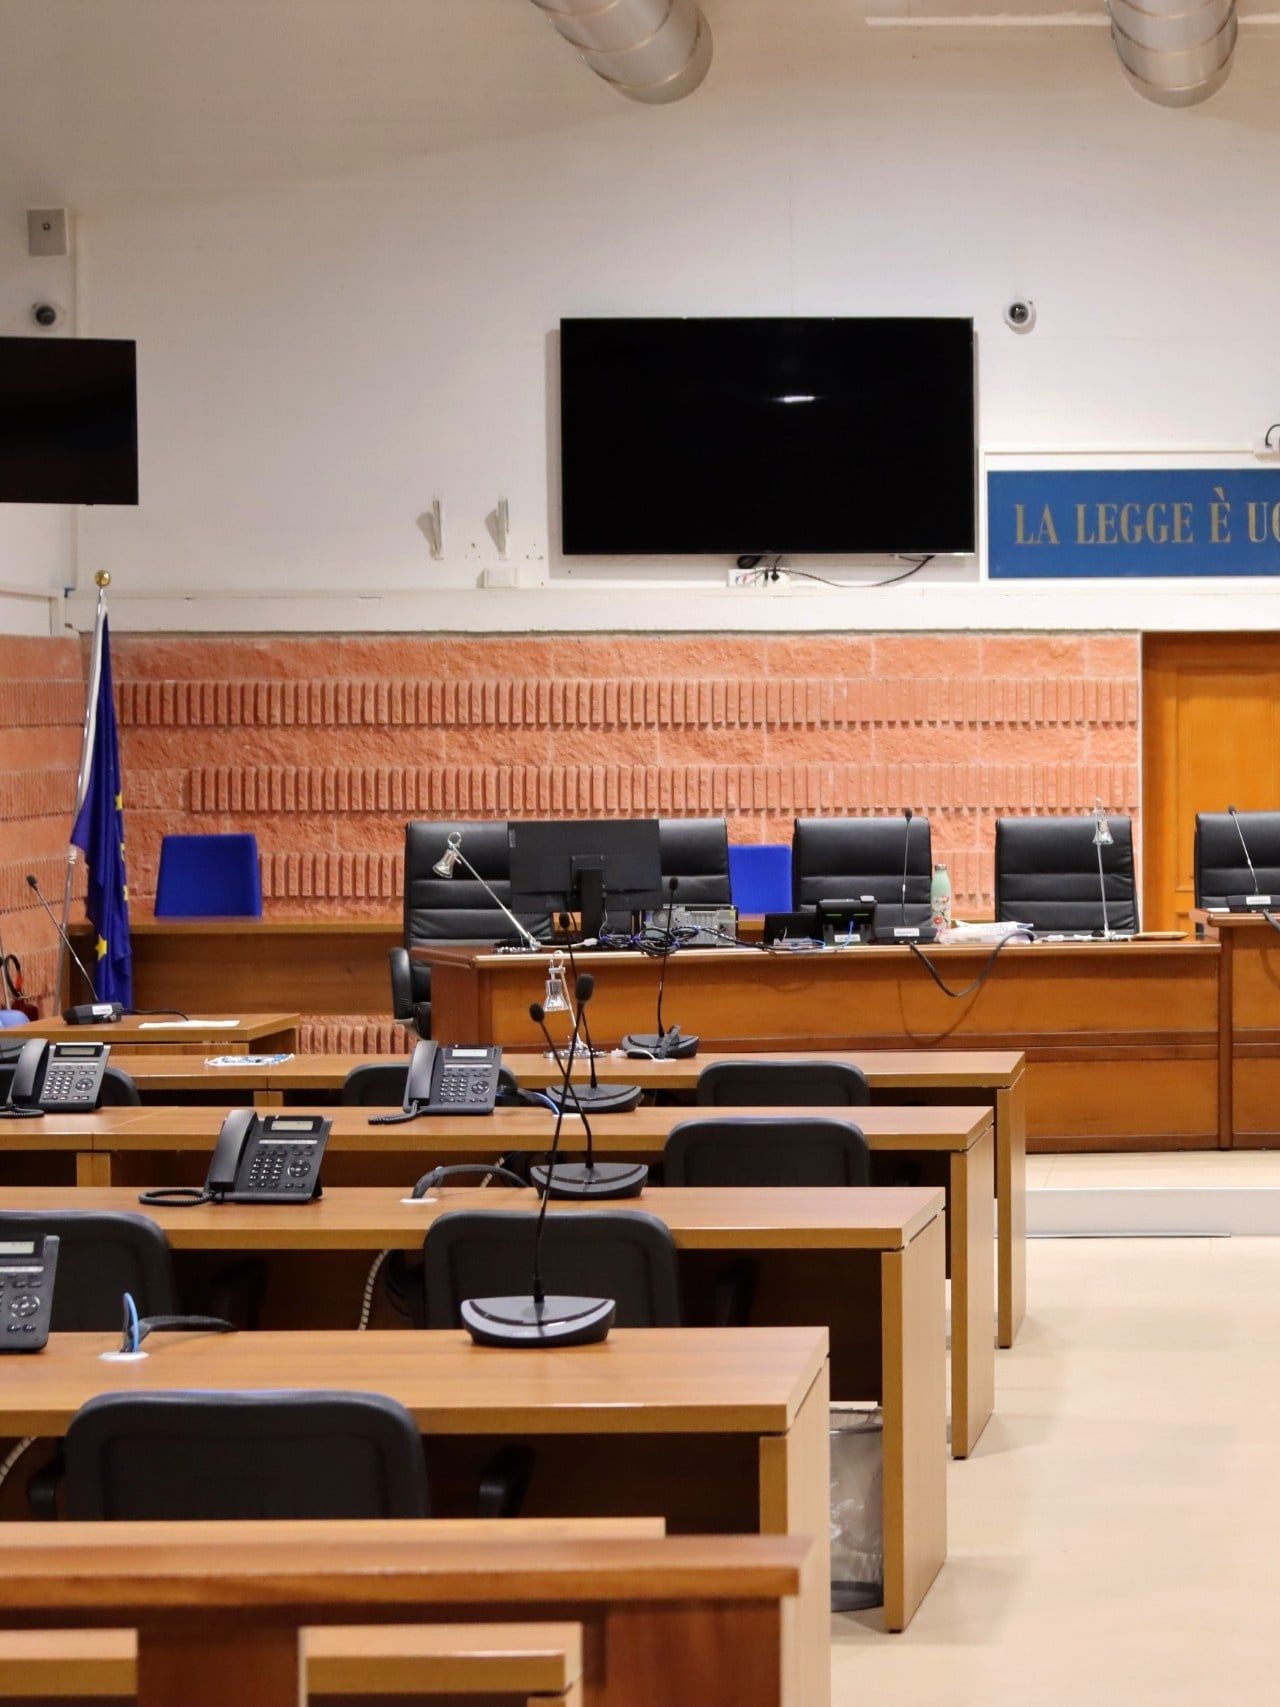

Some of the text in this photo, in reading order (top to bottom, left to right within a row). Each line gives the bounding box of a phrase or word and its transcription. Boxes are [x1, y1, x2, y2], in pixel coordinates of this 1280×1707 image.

[1014, 503, 1060, 545] LA
[1074, 502, 1194, 545] LEGGE
[1209, 486, 1231, 543] È
